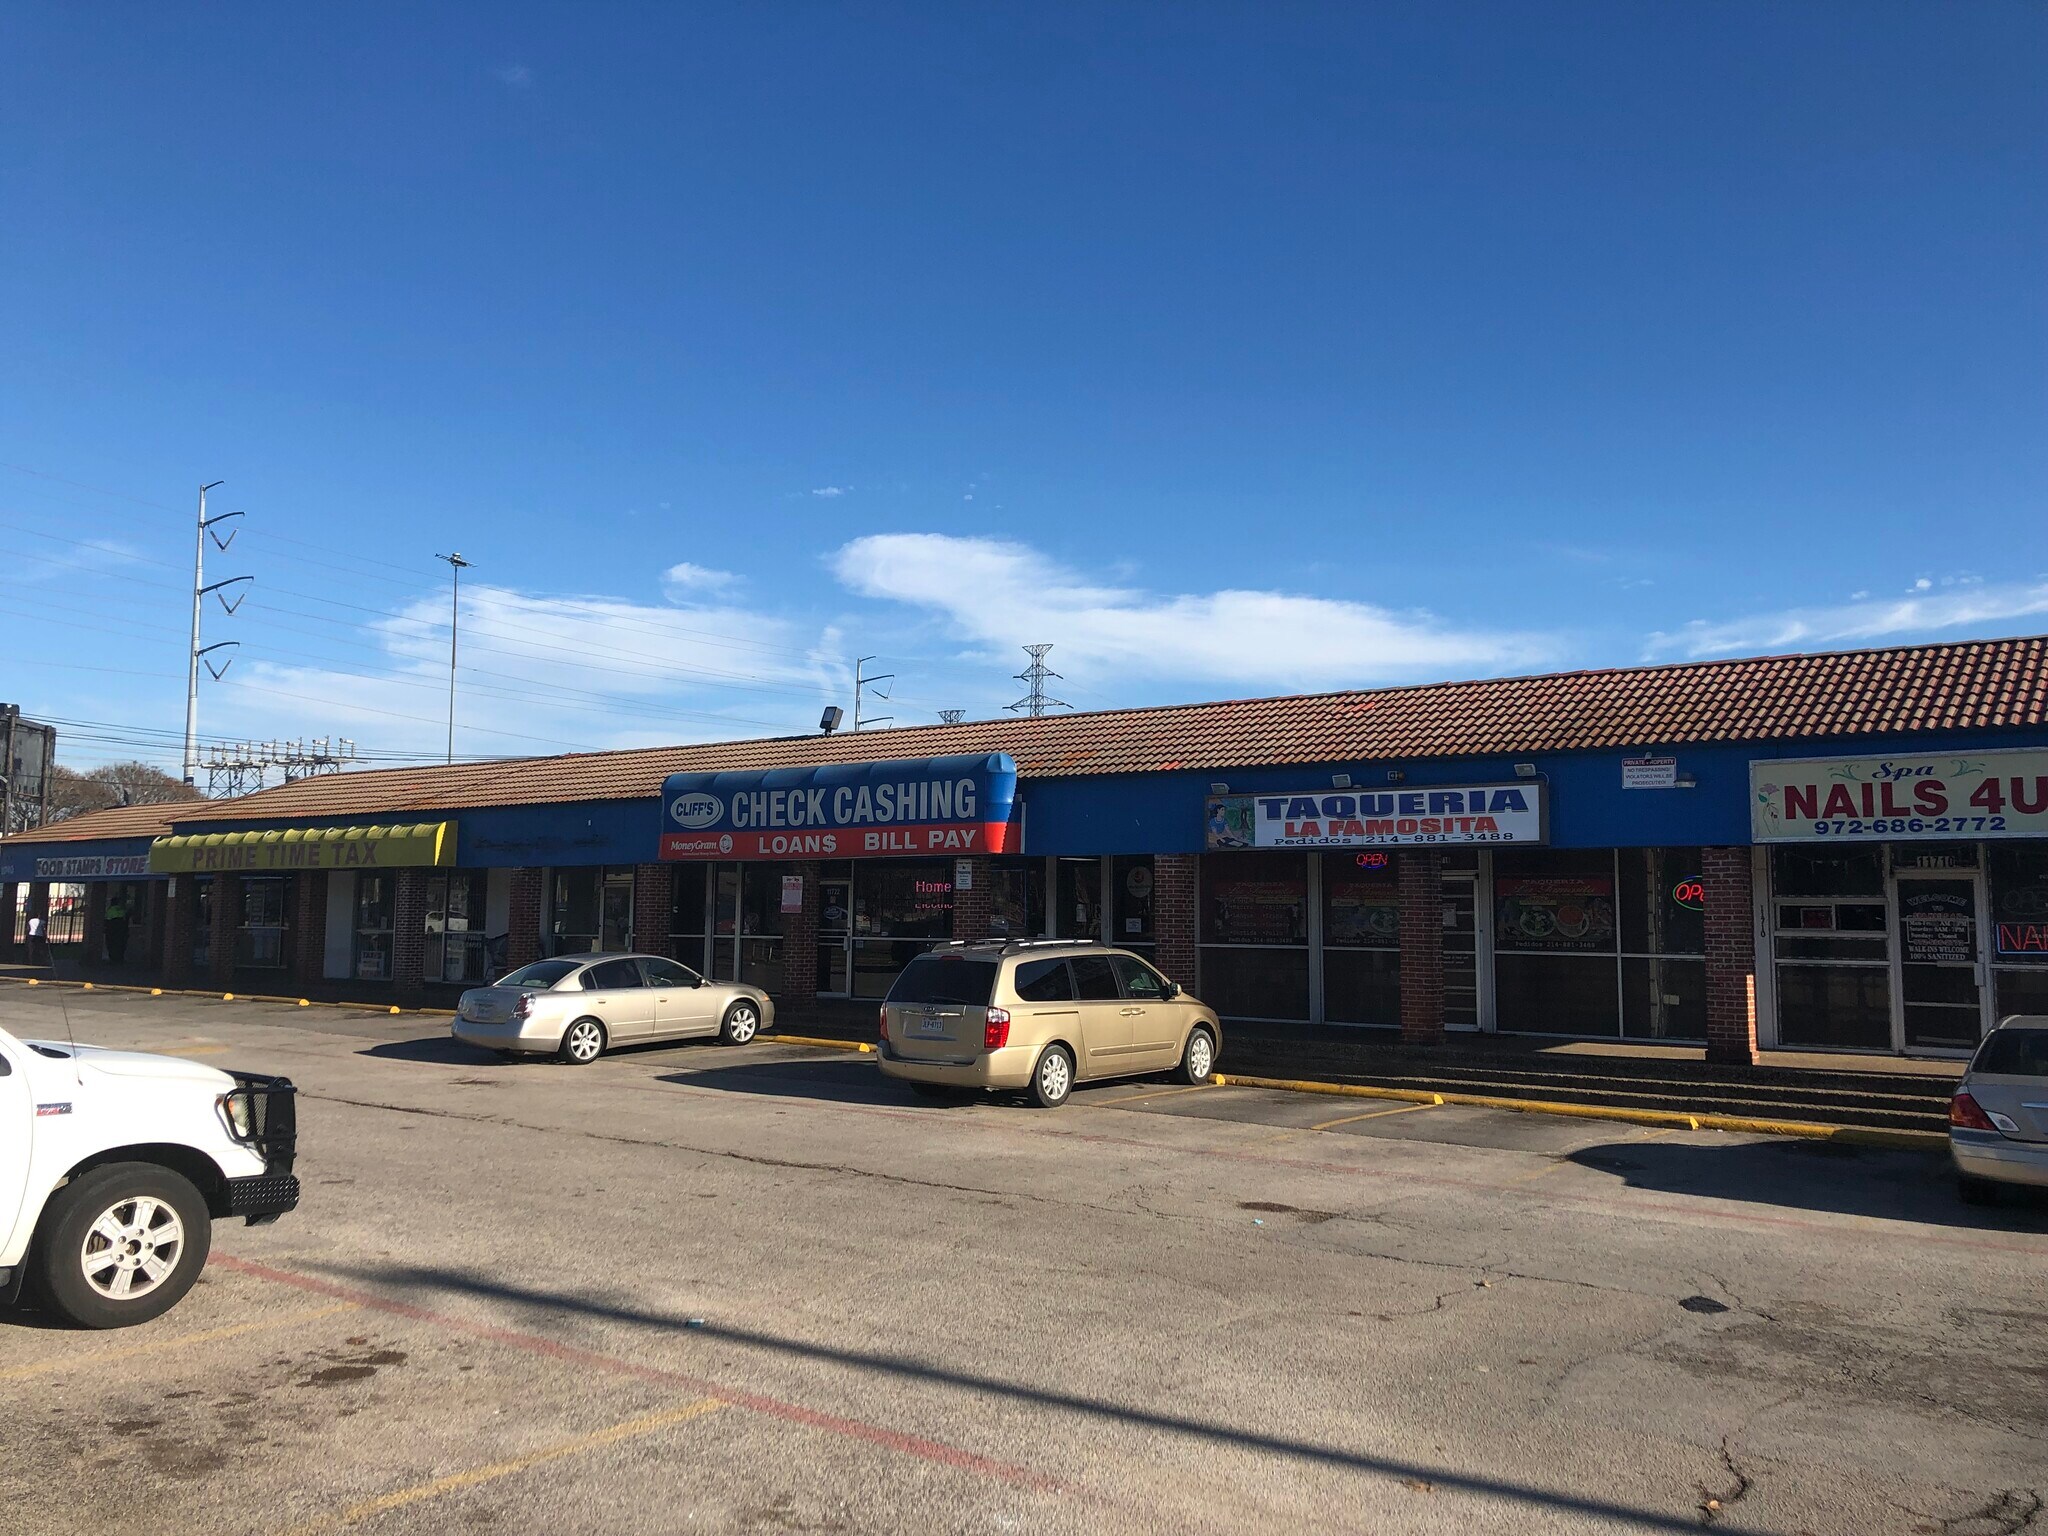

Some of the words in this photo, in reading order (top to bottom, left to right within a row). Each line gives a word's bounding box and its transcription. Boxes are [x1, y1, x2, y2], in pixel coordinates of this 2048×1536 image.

[1872, 762, 1937, 782] Spa
[732, 788, 827, 827] CHECK
[833, 778, 975, 824] CASHING
[1258, 789, 1529, 821] TAQUERIA
[1784, 779, 1949, 819] NAILS
[676, 801, 715, 817] CLIFF'S
[1285, 821, 1321, 838] LA
[1329, 816, 1499, 837] FAMOSITA
[1814, 816, 2006, 835] 972-686-2772
[671, 840, 717, 852] MoneyGram
[758, 833, 836, 854] LOAN$
[865, 832, 917, 851] BILL
[929, 829, 976, 848] PAY
[1274, 835, 1352, 846] Pedidos
[1366, 831, 1514, 844] 214-881-3488
[193, 846, 257, 868] PRIME
[266, 844, 321, 867] TIME
[331, 842, 377, 865] TAX
[1356, 853, 1388, 866] OPEN
[1918, 856, 1954, 867] 11710
[38, 859, 63, 876] FOOD
[66, 857, 101, 875] STAMPS
[105, 856, 145, 874] STORE
[916, 880, 952, 892] Home
[1906, 893, 1968, 907] WELCOME
